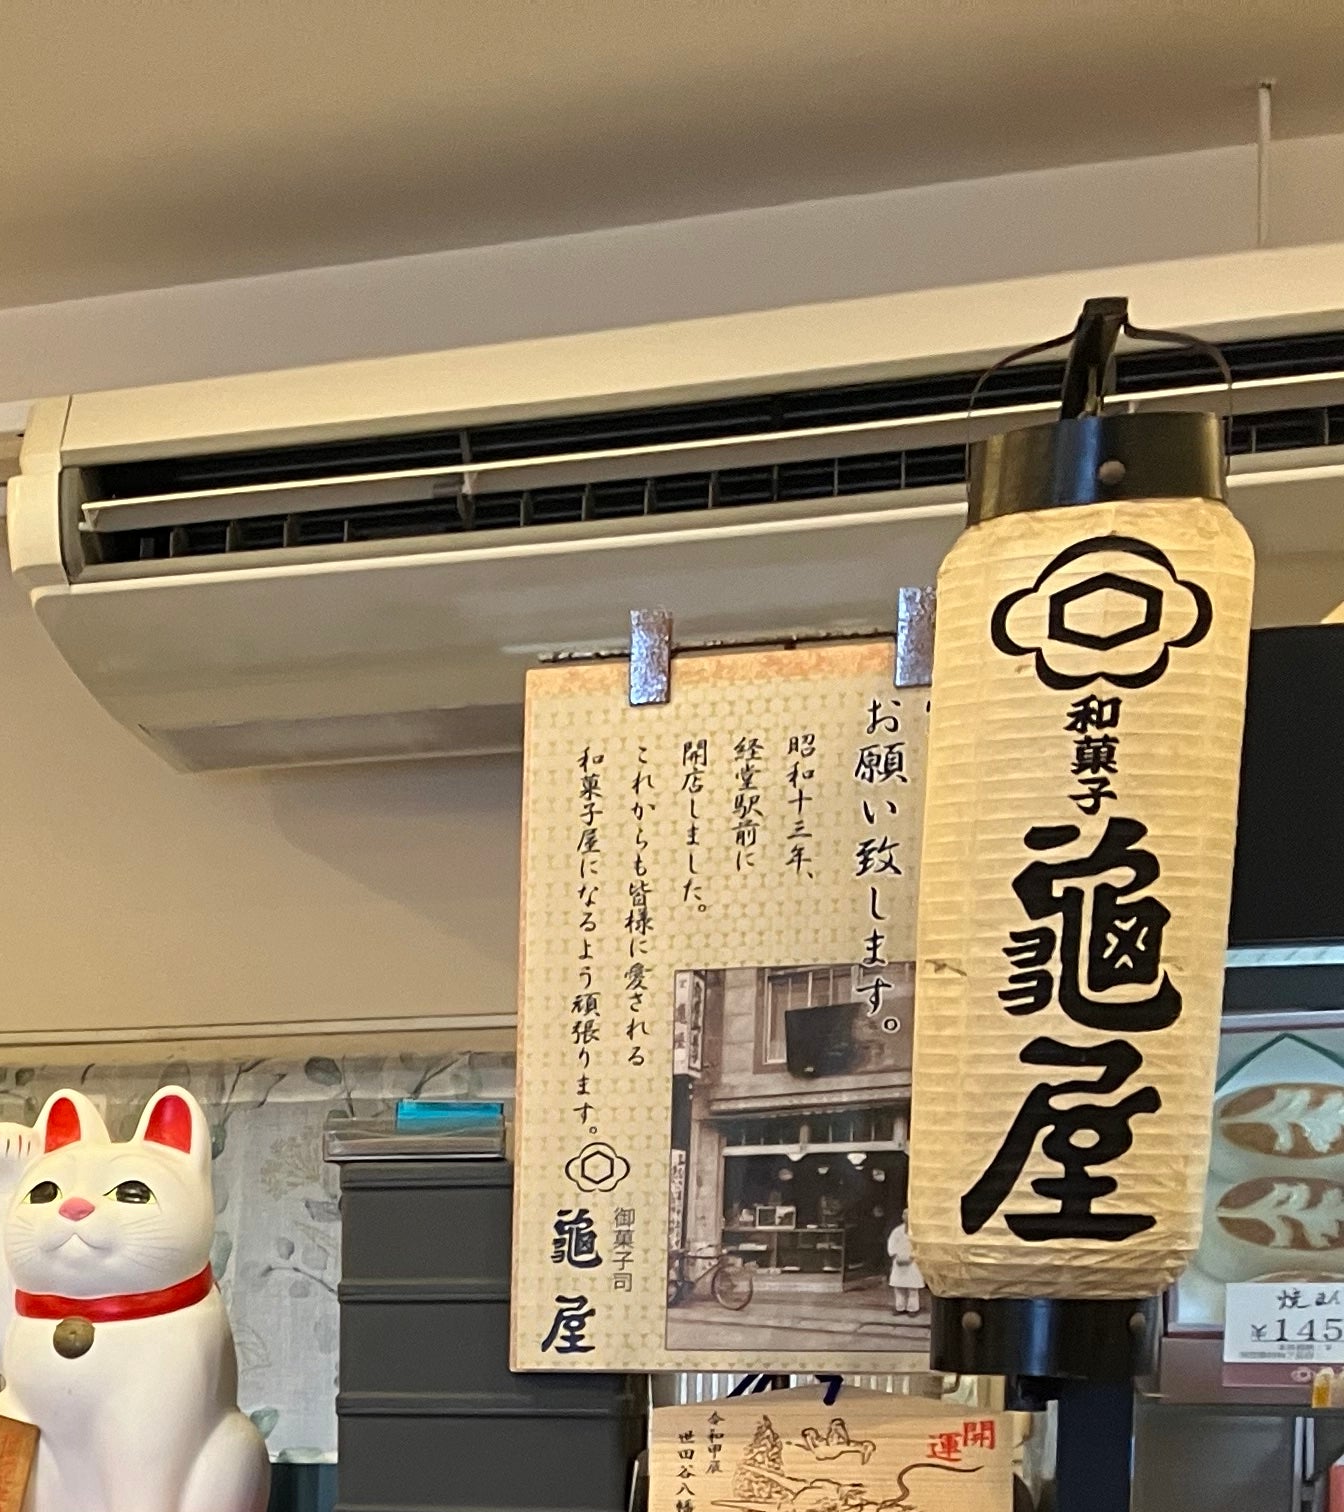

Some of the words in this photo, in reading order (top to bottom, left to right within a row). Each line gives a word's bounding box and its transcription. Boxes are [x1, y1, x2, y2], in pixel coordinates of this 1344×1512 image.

[731, 736, 765, 872] 経堂駅前に
[786, 734, 816, 880] 昭和十三年、
[1065, 694, 1121, 811] 和菓子
[681, 739, 709, 913] 開店しました。
[855, 700, 910, 1033] お願い致します。
[570, 746, 604, 1136] 和菓子屋になるよう頑張ります。
[624, 745, 656, 1067] これからも皆様に愛される
[612, 1207, 636, 1293] 御菓子司
[1250, 1317, 1344, 1342] ¥145
[705, 1410, 726, 1475] 令和甲辰
